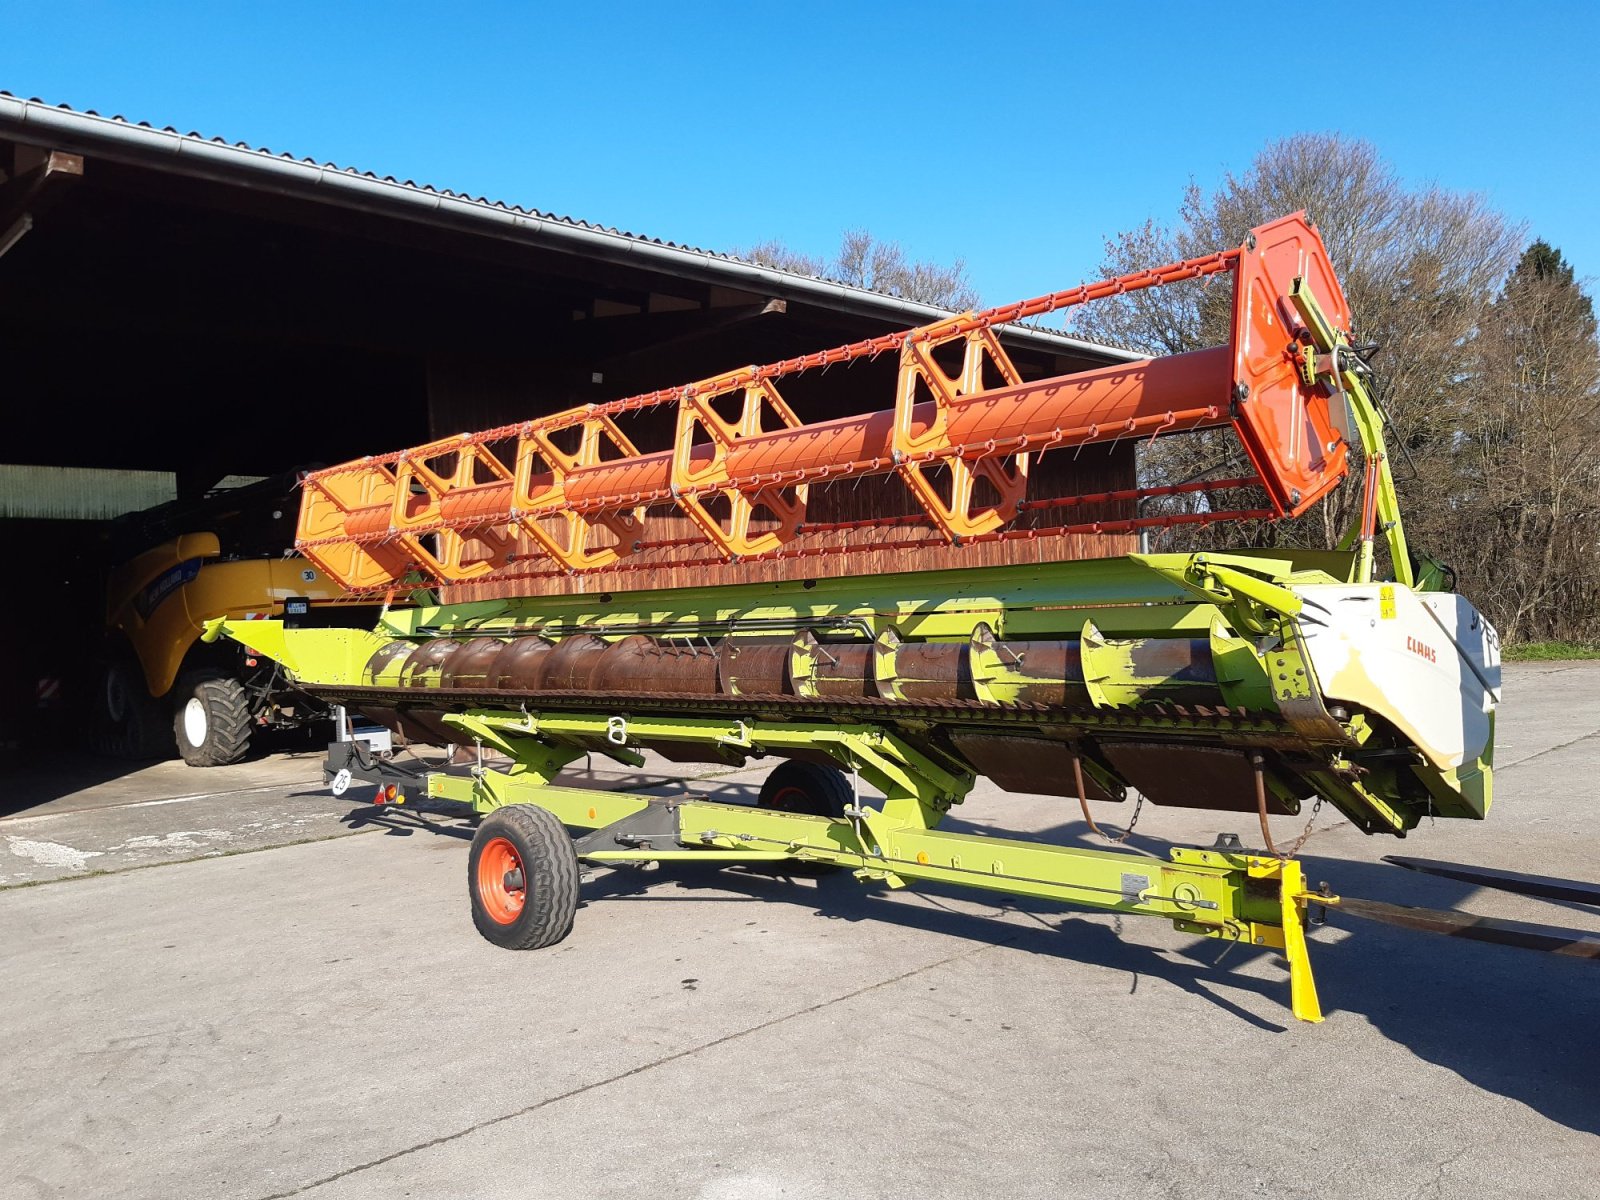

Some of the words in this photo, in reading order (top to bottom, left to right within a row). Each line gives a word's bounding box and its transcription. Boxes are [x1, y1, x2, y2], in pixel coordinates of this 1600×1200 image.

[303, 571, 314, 580] 30
[1407, 635, 1436, 664] CLAAS
[334, 773, 348, 790] 25
